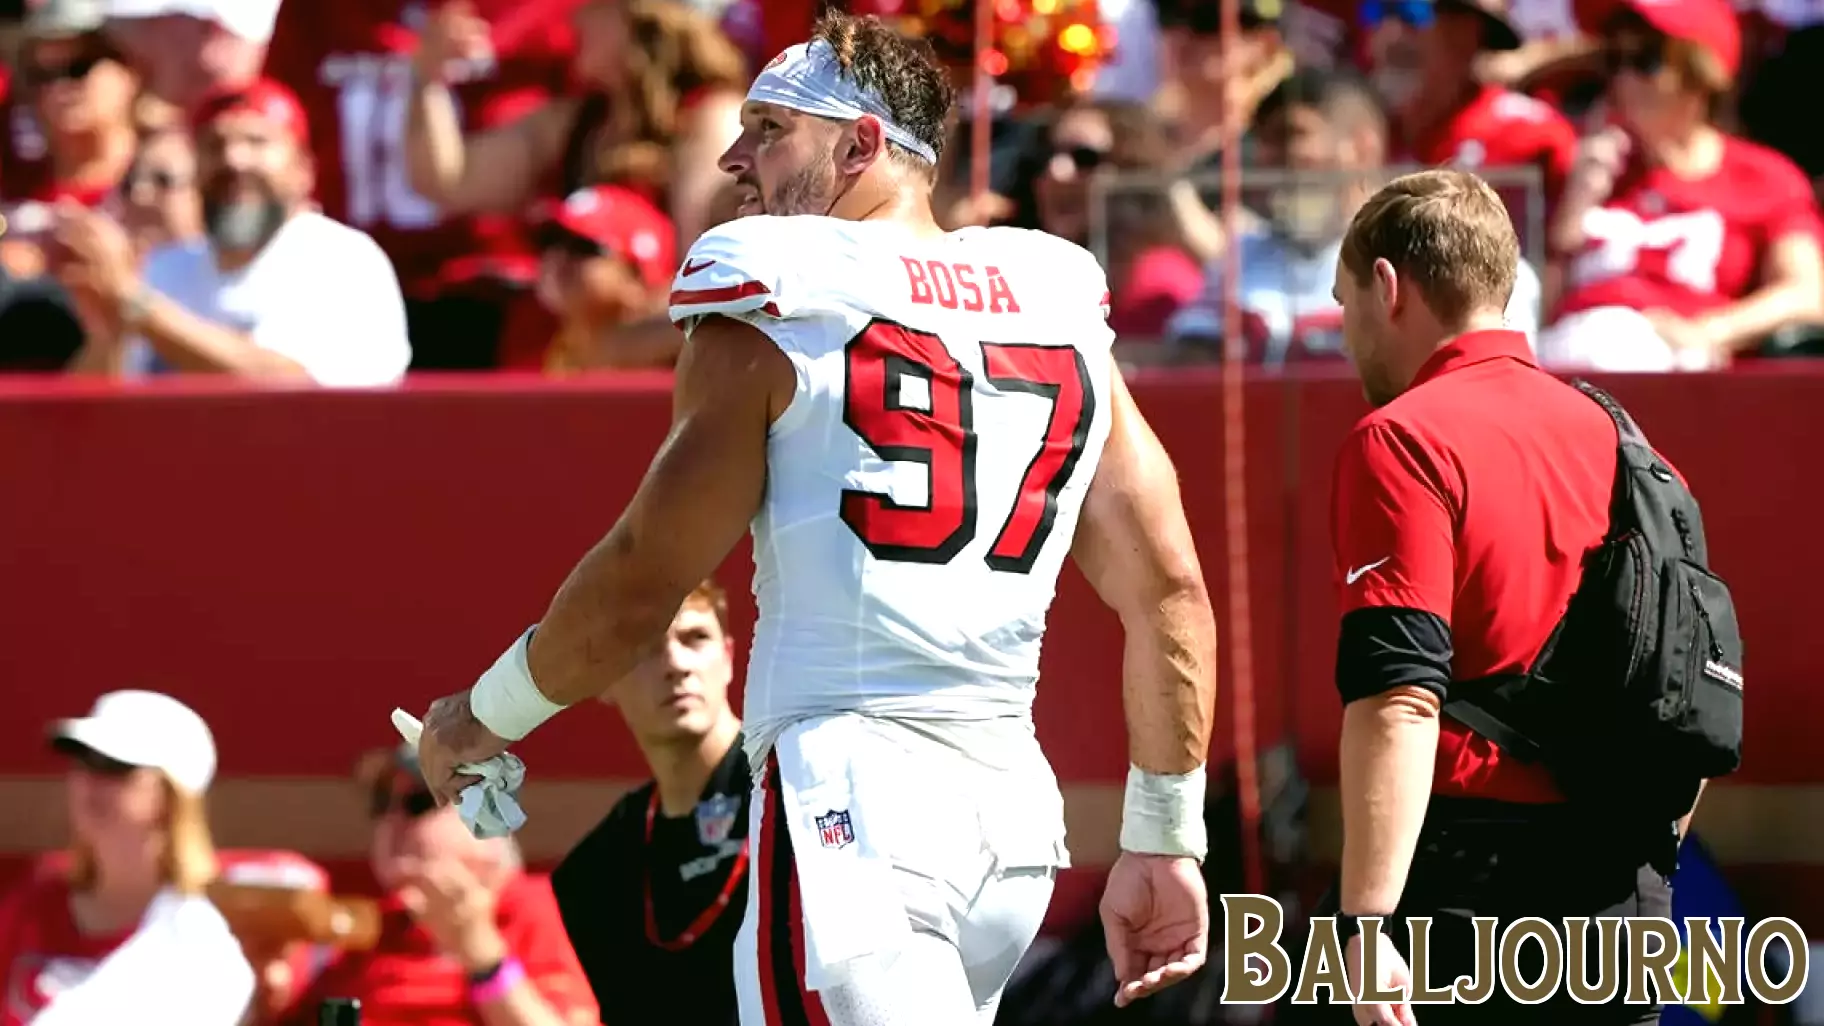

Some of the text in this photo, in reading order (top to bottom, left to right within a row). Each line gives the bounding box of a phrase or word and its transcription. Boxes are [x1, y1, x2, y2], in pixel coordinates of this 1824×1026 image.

[899, 256, 1021, 313] BOSA
[839, 317, 1097, 574] 97
[823, 824, 851, 844] NFL
